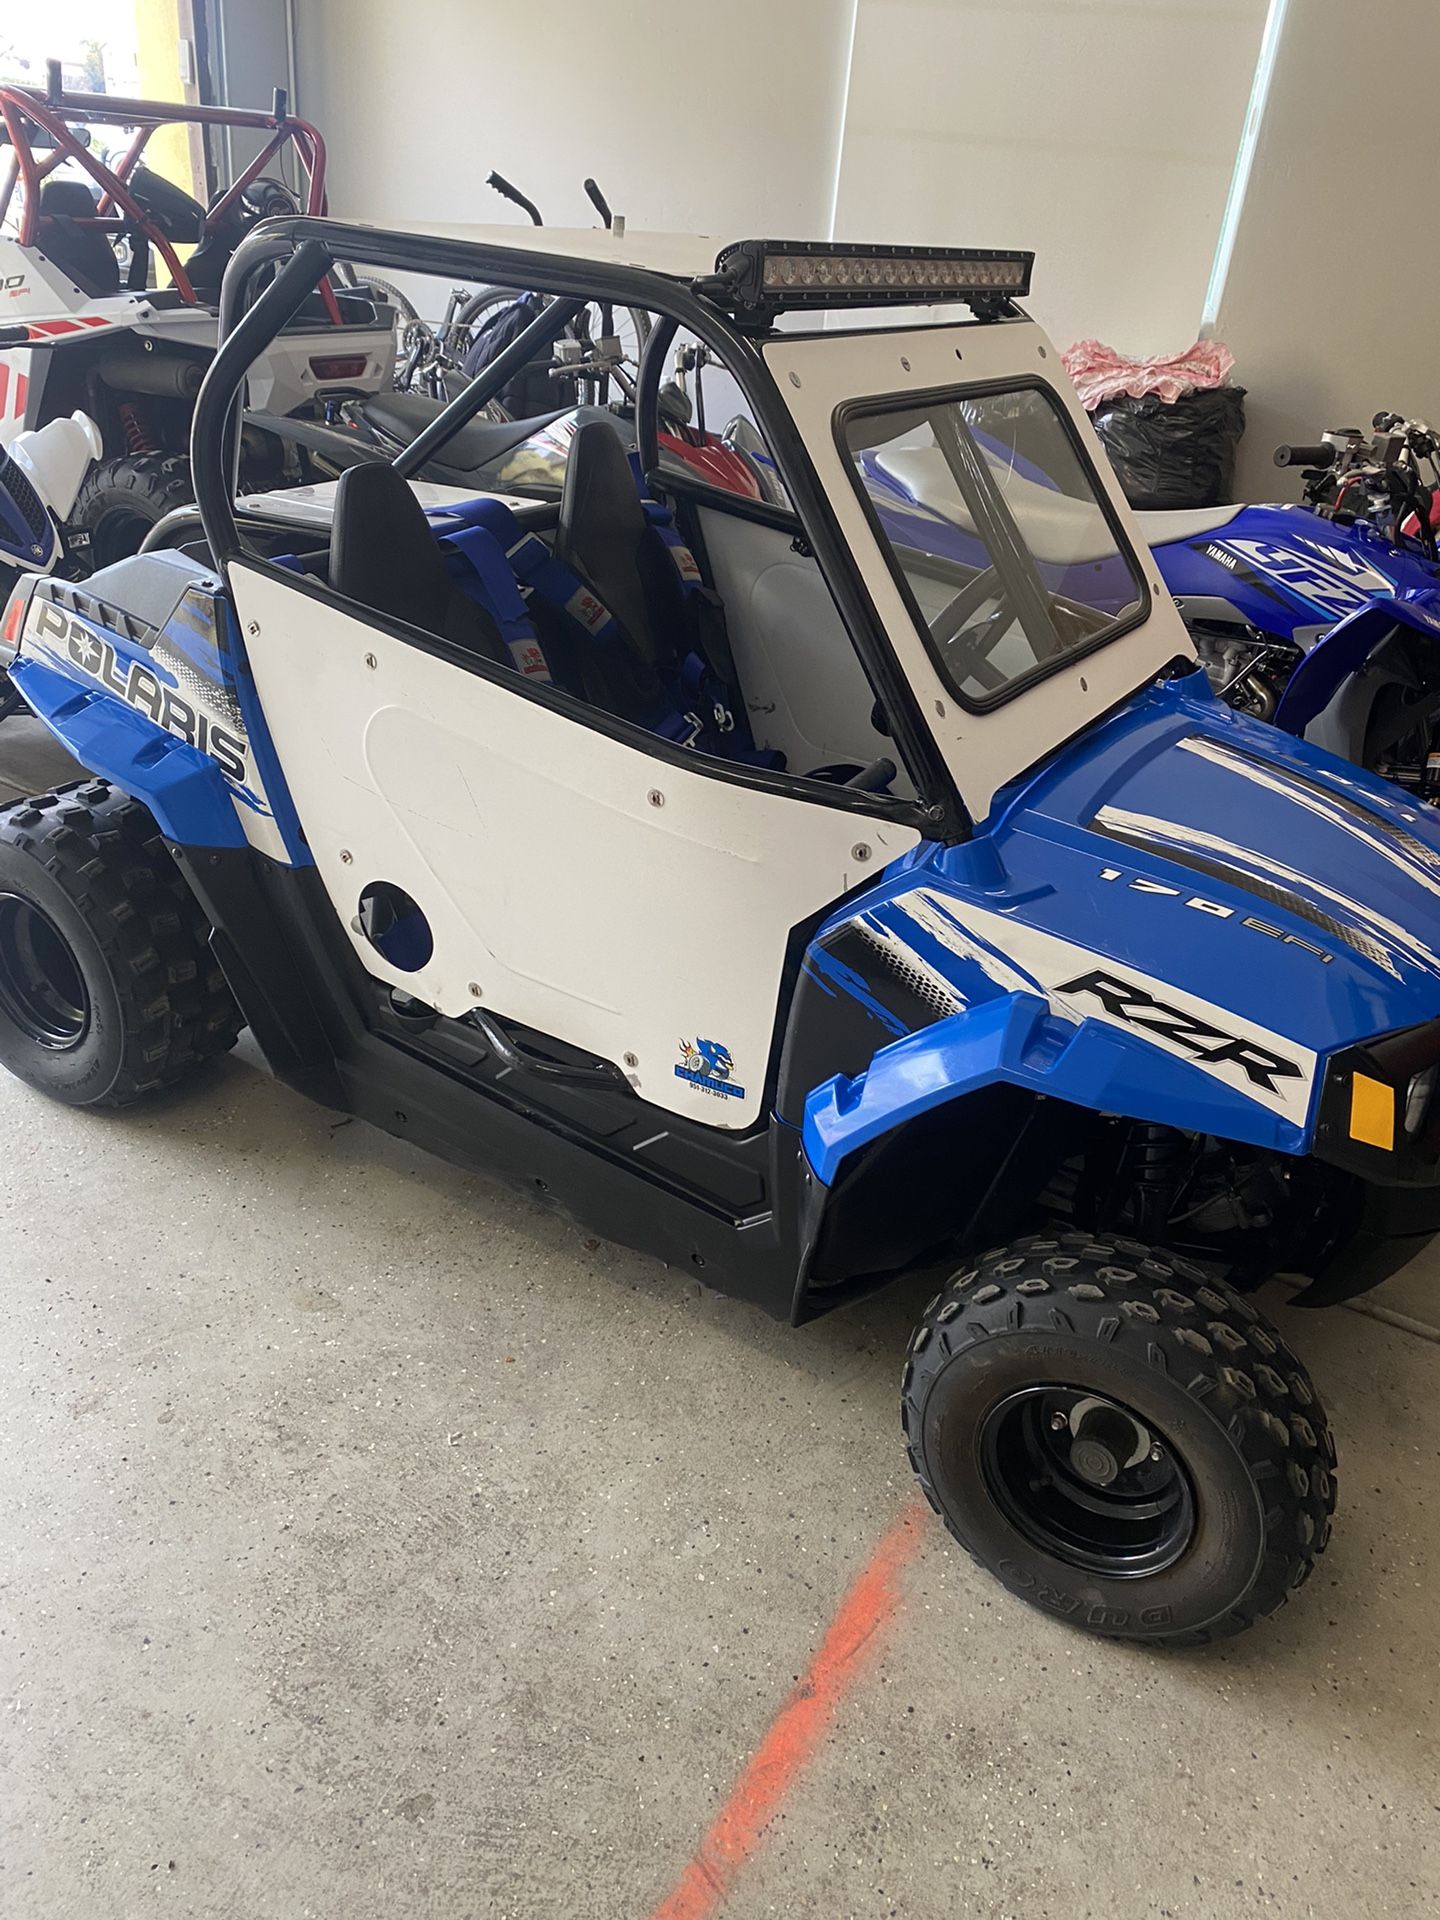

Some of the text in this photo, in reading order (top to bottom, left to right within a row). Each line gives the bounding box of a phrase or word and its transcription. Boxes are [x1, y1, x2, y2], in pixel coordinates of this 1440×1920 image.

[1205, 544, 1237, 570] YAMAHA
[36, 602, 249, 783] POLARIS
[1098, 867, 1336, 965] 170 EFI
[1051, 969, 1306, 1096] RZR
[675, 1066, 745, 1098] CHAMUCO
[999, 1558, 1173, 1627] DURO
